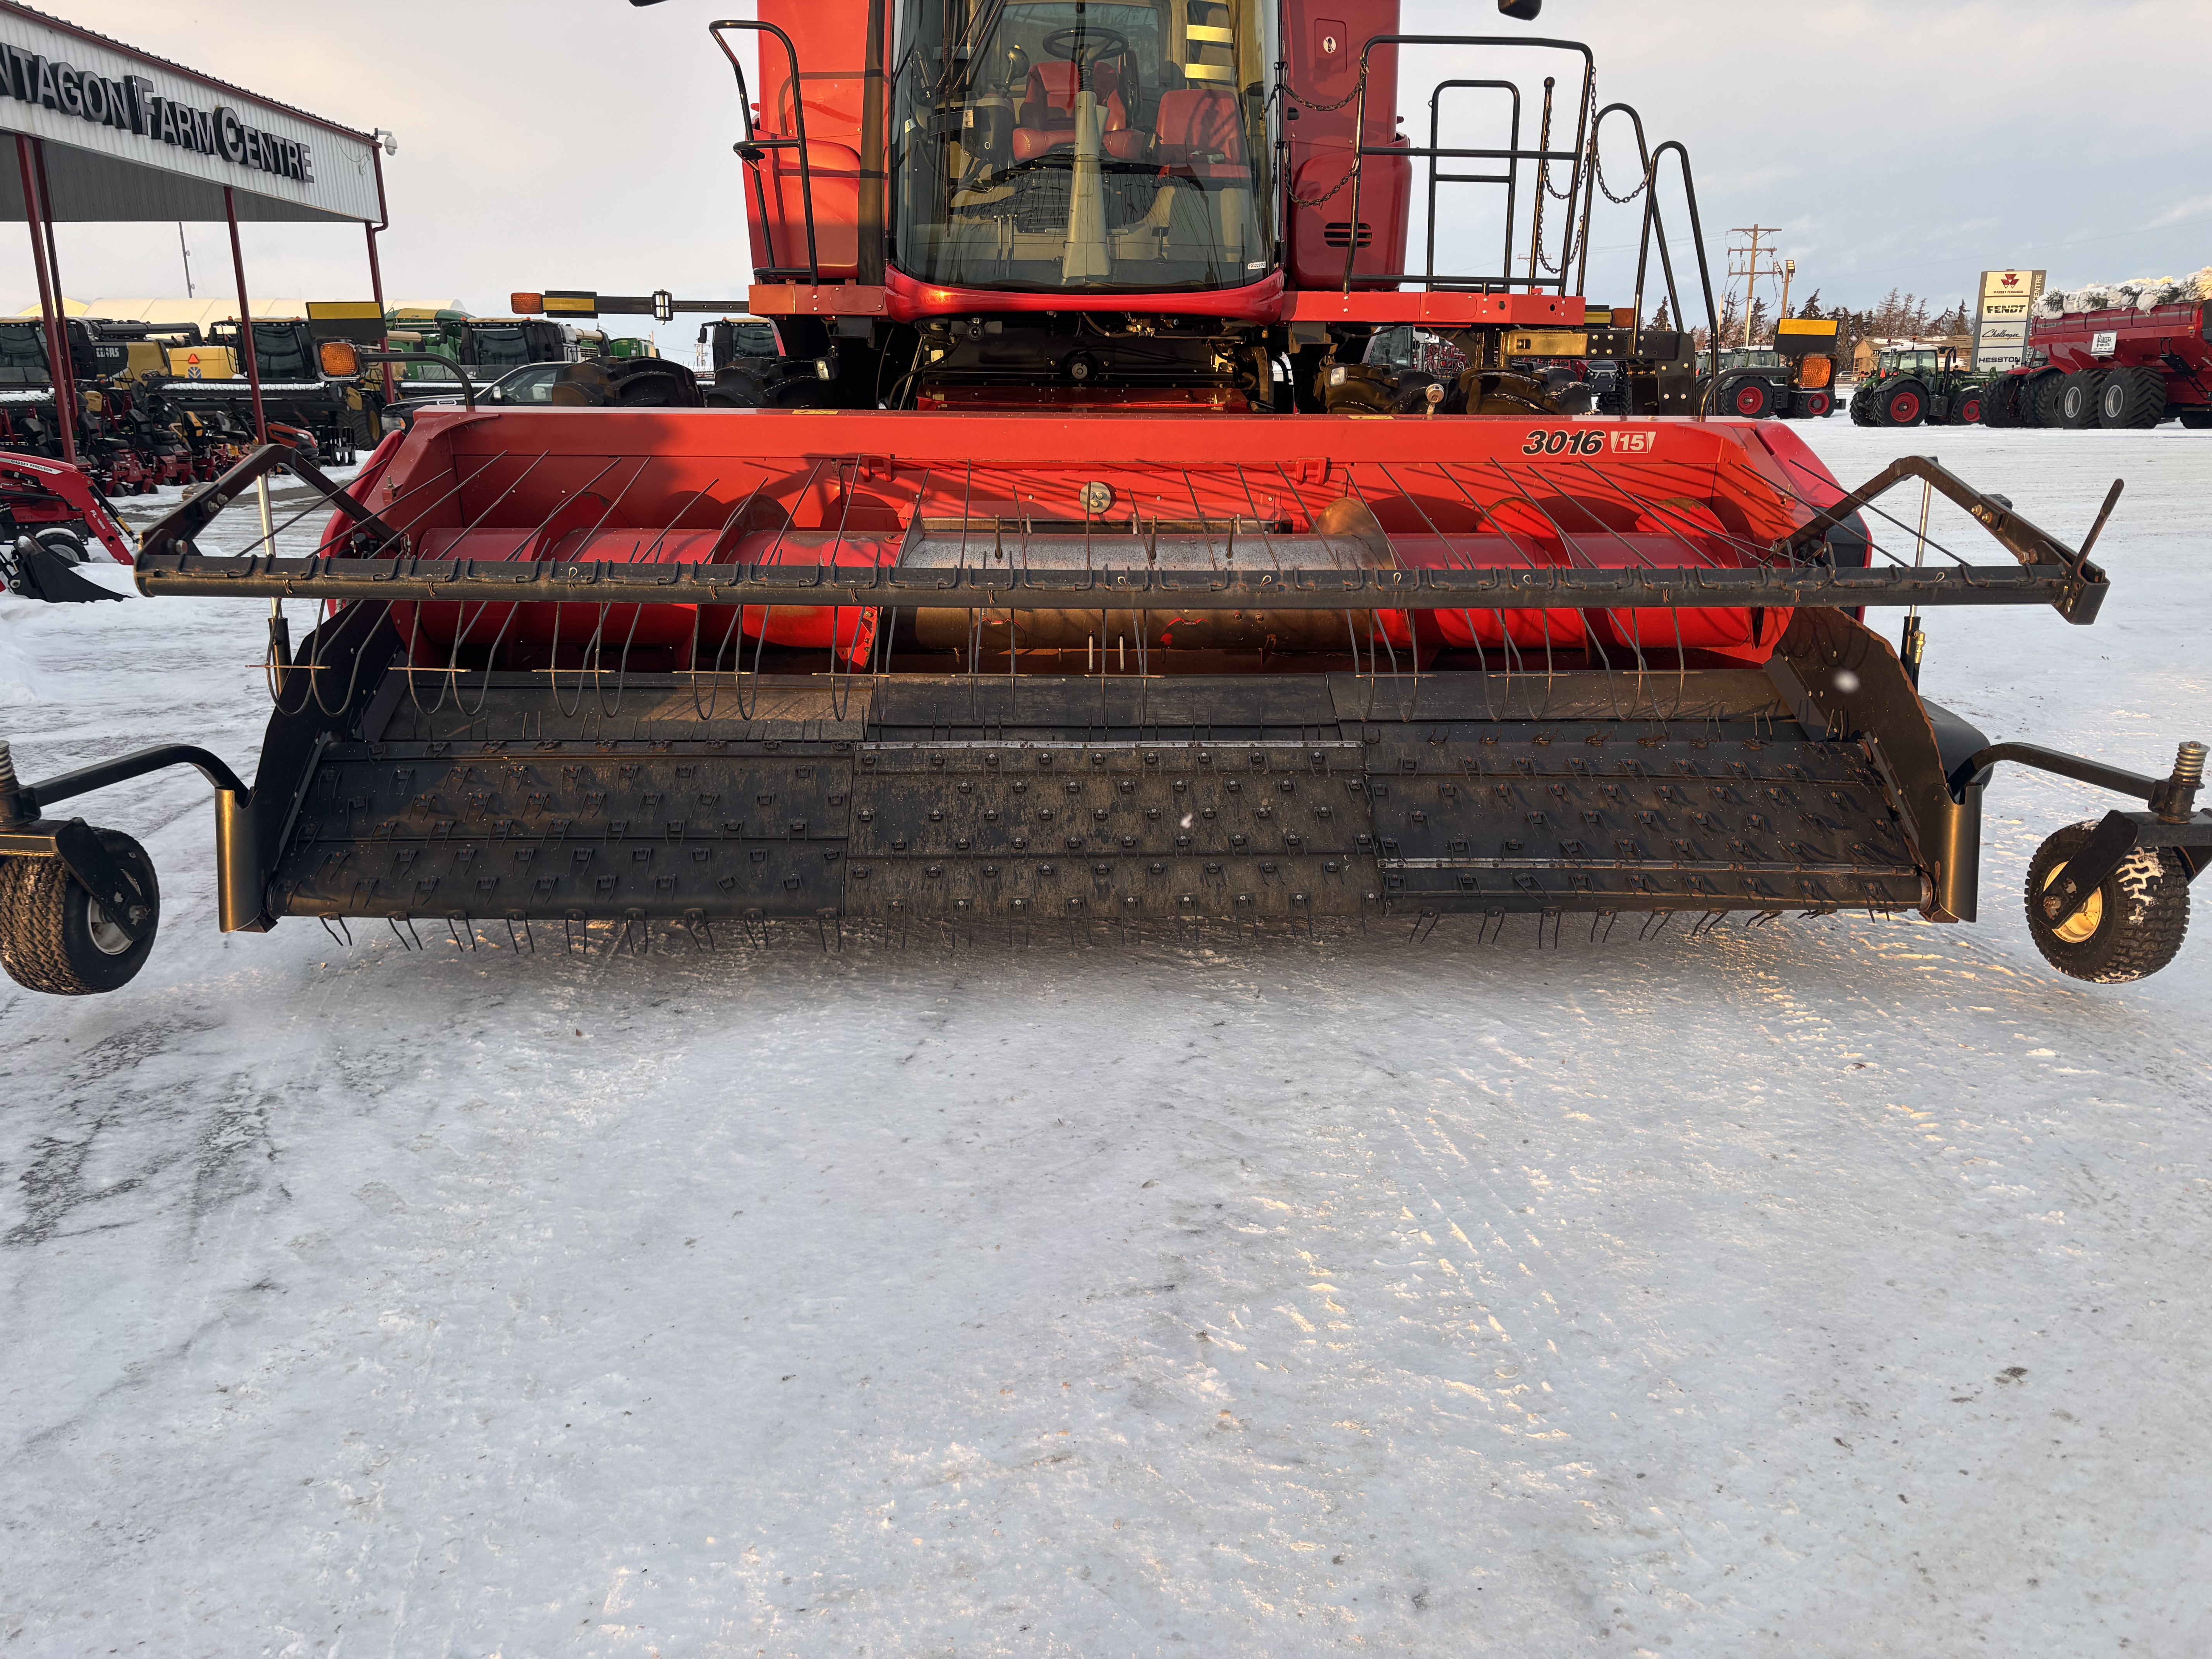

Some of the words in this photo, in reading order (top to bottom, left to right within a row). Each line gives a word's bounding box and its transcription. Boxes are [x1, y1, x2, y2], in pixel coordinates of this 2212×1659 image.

[213, 107, 314, 183] CENTRE
[2033, 275, 2042, 302] CENTRE
[1987, 305, 2026, 313] FENDT
[1982, 329, 2023, 340] Challenger
[1522, 429, 1606, 456] 3016
[1620, 434, 1645, 451] 15
